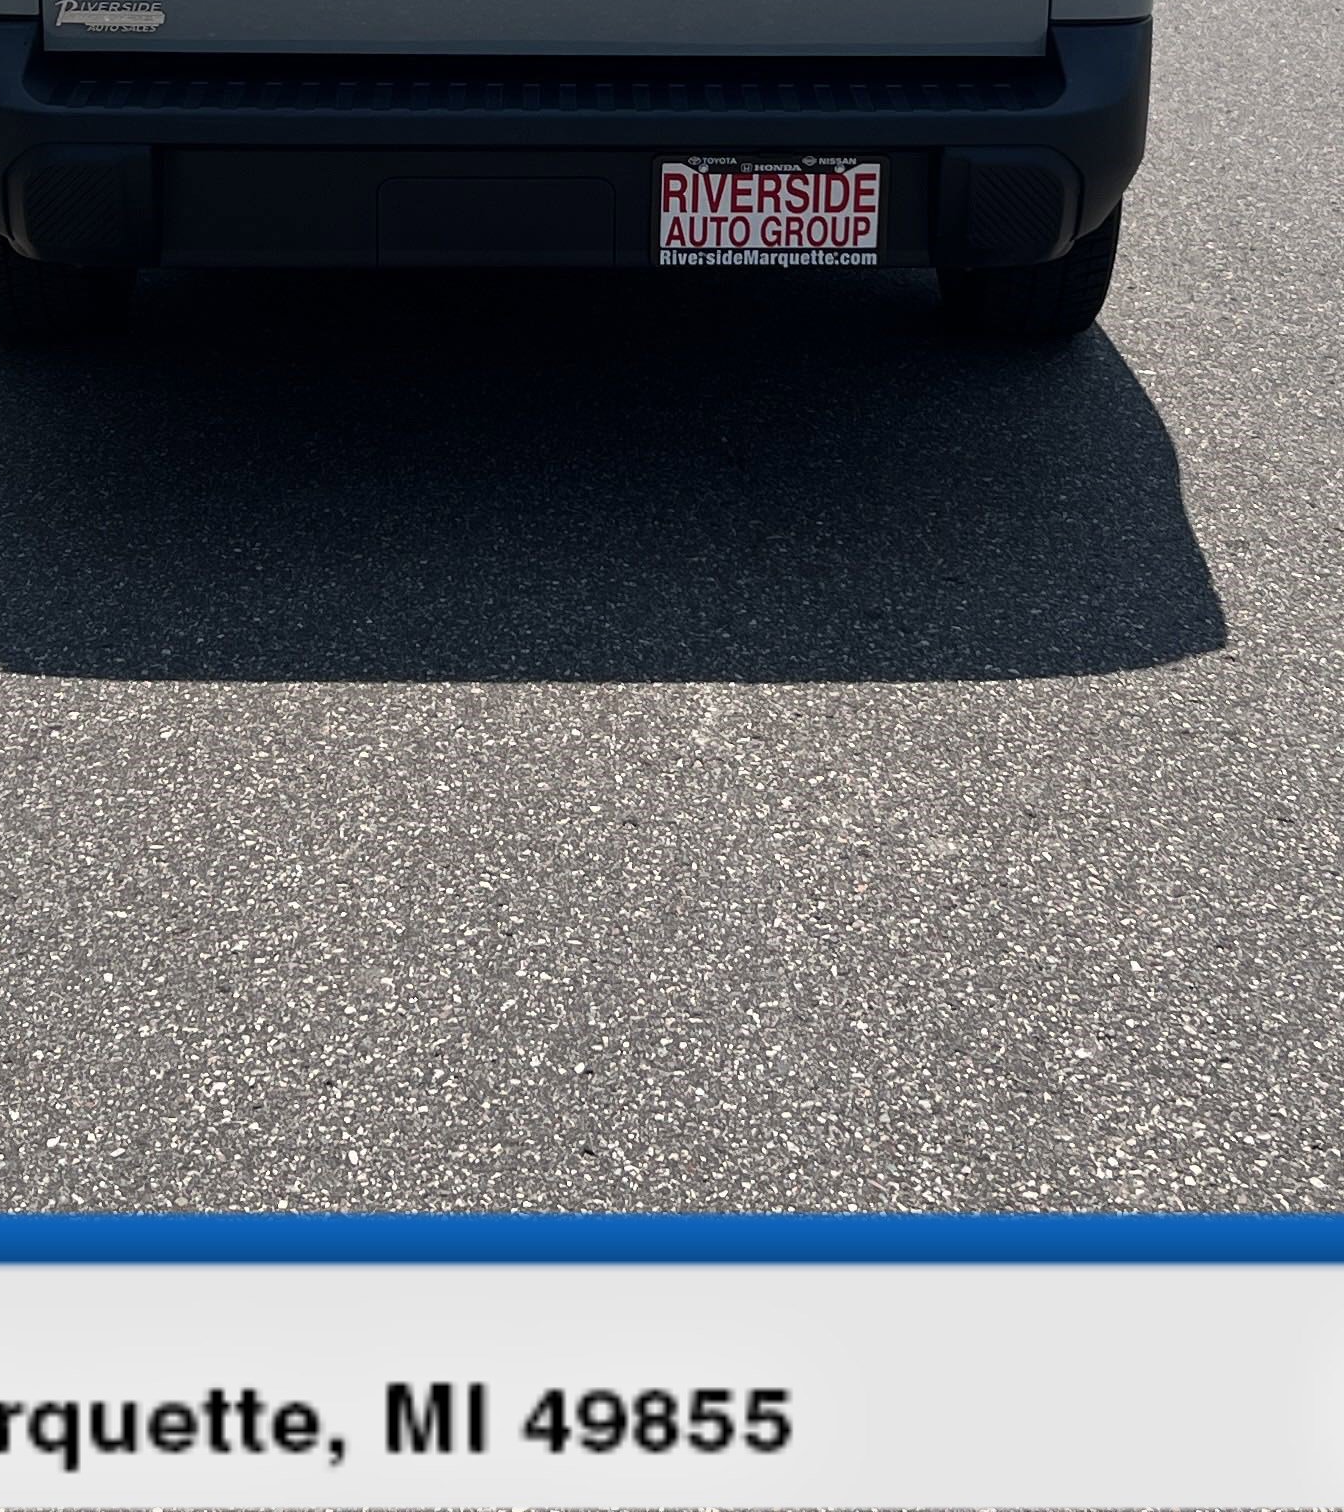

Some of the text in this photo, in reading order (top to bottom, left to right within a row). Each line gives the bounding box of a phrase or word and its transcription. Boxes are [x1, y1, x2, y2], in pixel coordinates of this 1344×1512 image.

[55, 0, 161, 26] RIVERSIDE
[87, 24, 157, 33] AUTO SALES
[702, 157, 737, 165] TOYOTA
[754, 164, 802, 172] HONDA
[818, 157, 857, 166] NISSAN
[662, 173, 877, 213] RIVERSIDE
[665, 216, 871, 247] AUTO GROUP
[659, 249, 877, 268] RiversideMarquette.com
